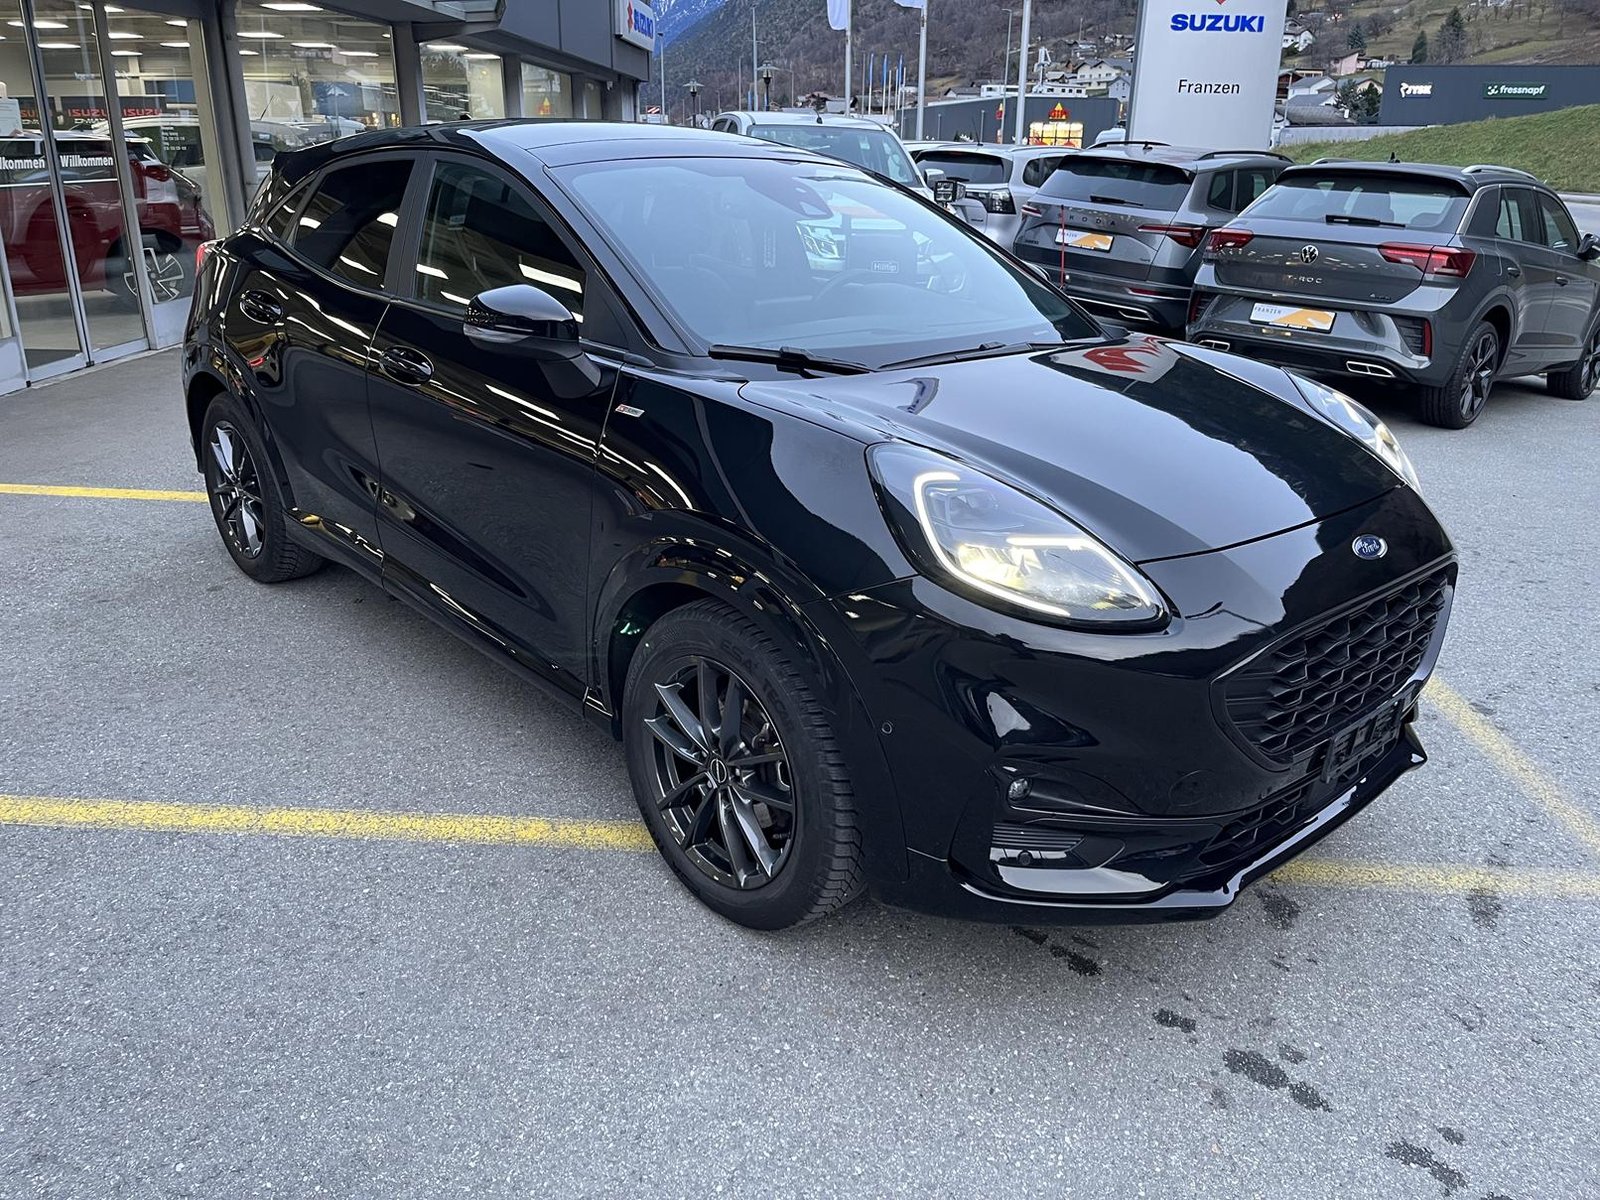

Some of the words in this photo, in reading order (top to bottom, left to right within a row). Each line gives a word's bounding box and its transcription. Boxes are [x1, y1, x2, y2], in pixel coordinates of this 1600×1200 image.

[1170, 13, 1265, 32] SUZUKI
[1178, 79, 1241, 94] Franzen
[1499, 85, 1546, 98] fressnapf
[0, 156, 46, 170] lkommen
[60, 154, 114, 168] Willkommen
[1287, 274, 1323, 284] T-ROC
